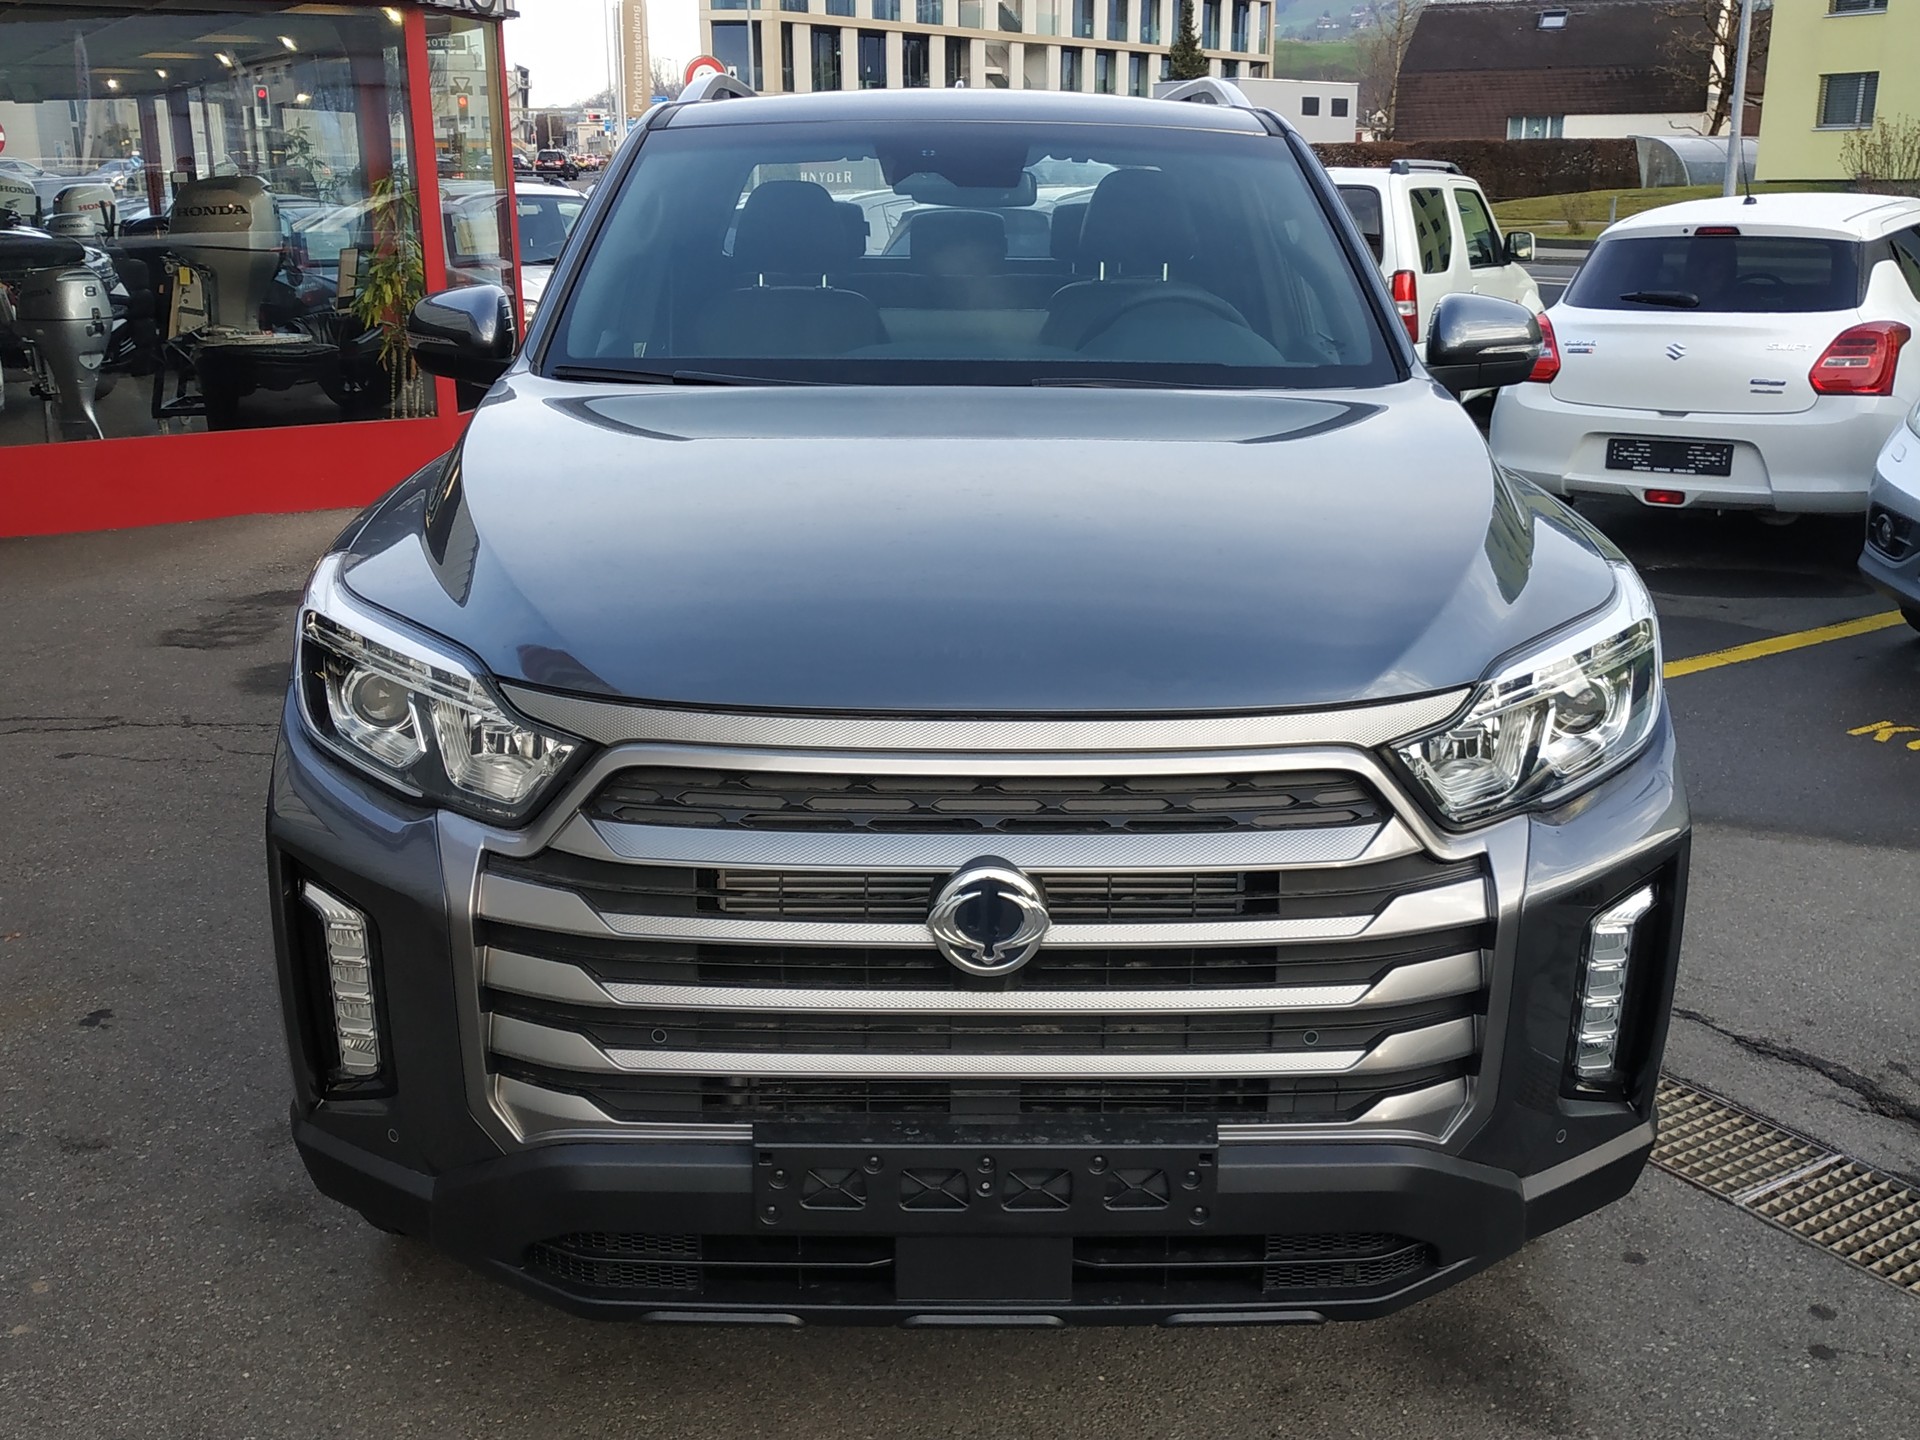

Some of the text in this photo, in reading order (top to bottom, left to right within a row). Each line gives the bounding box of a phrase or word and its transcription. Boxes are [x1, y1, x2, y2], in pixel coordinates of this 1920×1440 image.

[632, 5, 643, 112] Parkettausstellung
[176, 204, 248, 216] HONDA
[83, 285, 97, 297] 8
